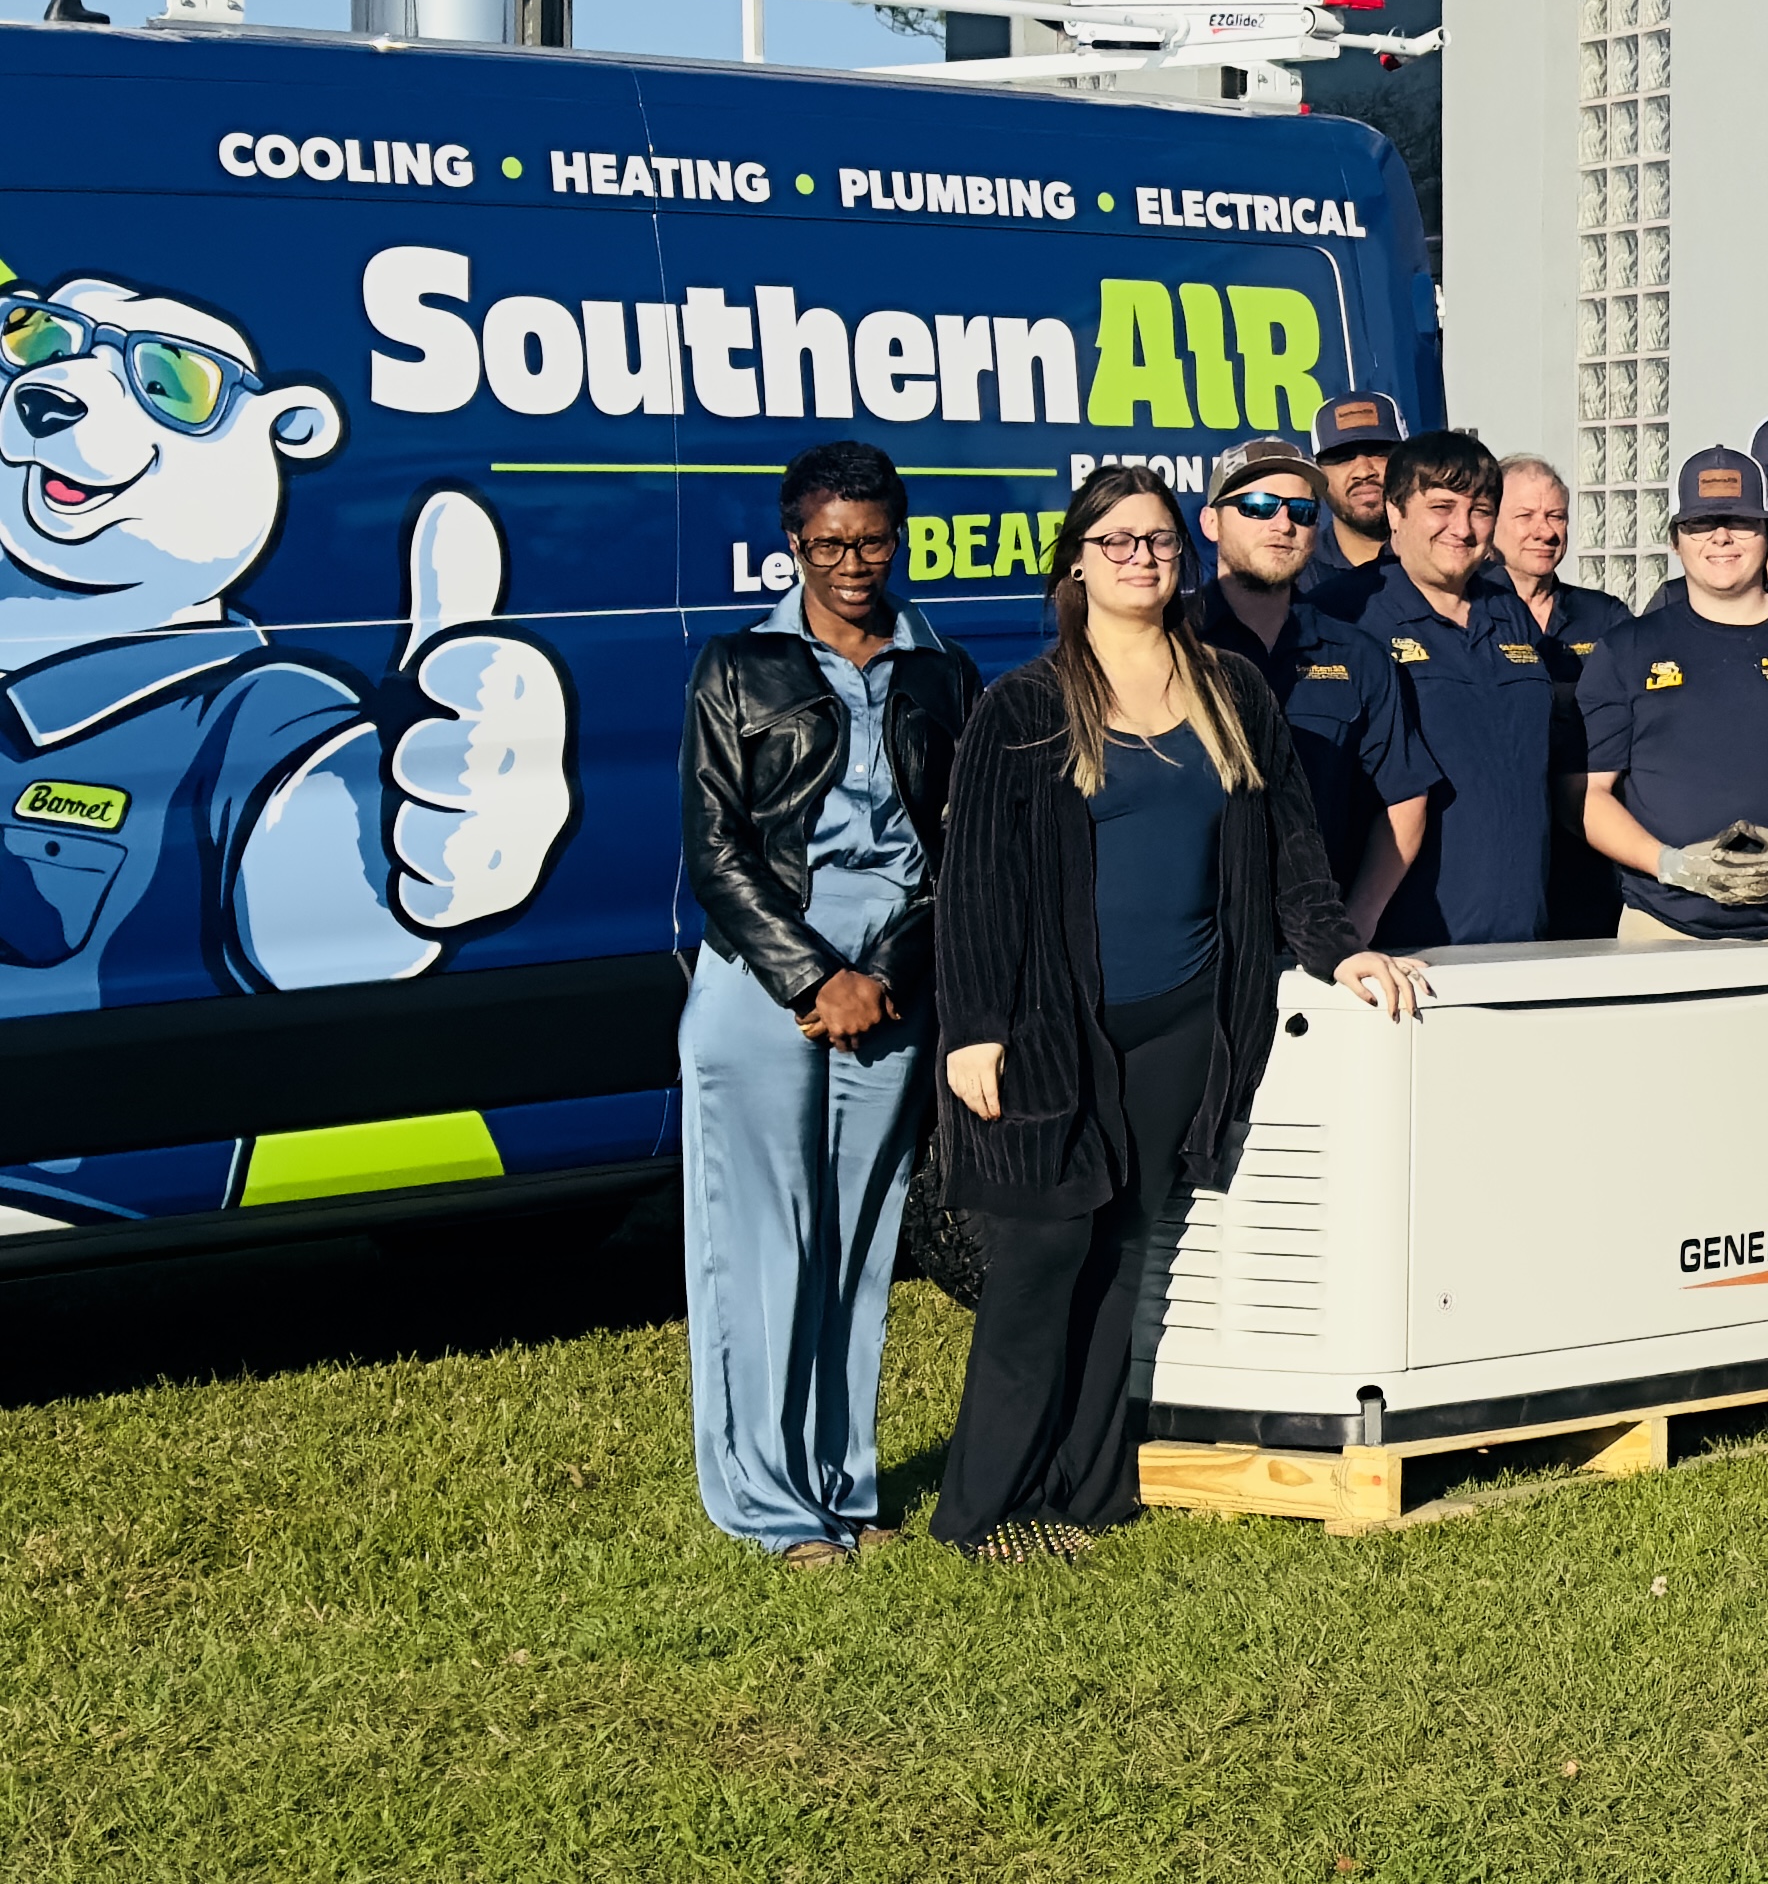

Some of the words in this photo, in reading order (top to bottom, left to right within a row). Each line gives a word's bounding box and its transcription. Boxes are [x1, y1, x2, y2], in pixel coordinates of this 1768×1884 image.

[1210, 13, 1265, 28] EZGlide2
[218, 132, 474, 188] COOLING
[550, 150, 771, 203] HEATING
[839, 168, 1076, 220] PLUMBING
[1135, 186, 1366, 238] ELECTRICAL
[733, 541, 798, 593] Le
[29, 785, 114, 822] Barret
